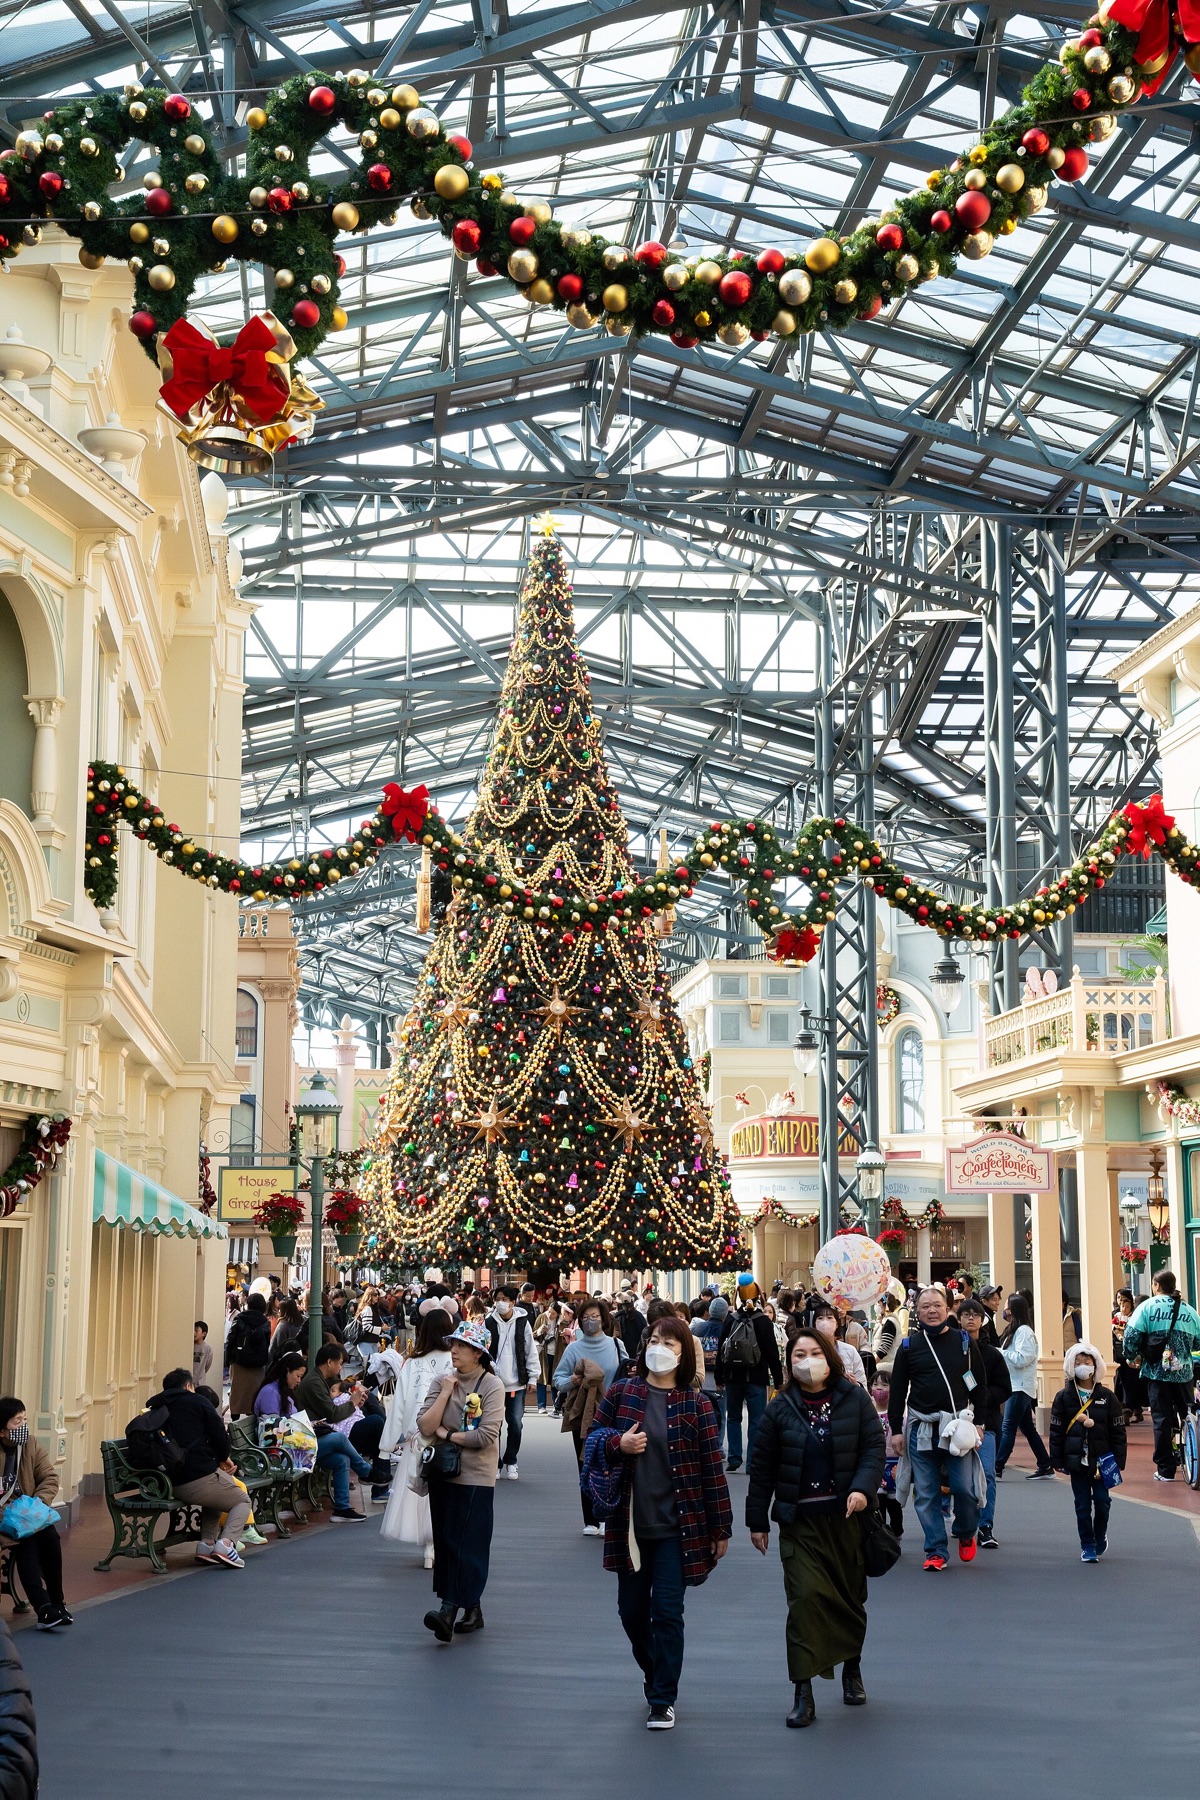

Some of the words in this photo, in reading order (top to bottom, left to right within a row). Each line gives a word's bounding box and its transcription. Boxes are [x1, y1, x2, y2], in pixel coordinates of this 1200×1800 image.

[970, 1141, 996, 1155] WORLD
[998, 1141, 1029, 1156] BAZAAR
[960, 1150, 1040, 1182] Confectionery
[237, 1175, 278, 1188] House
[252, 1188, 261, 1198] of
[1149, 1307, 1192, 1323] Aulni
